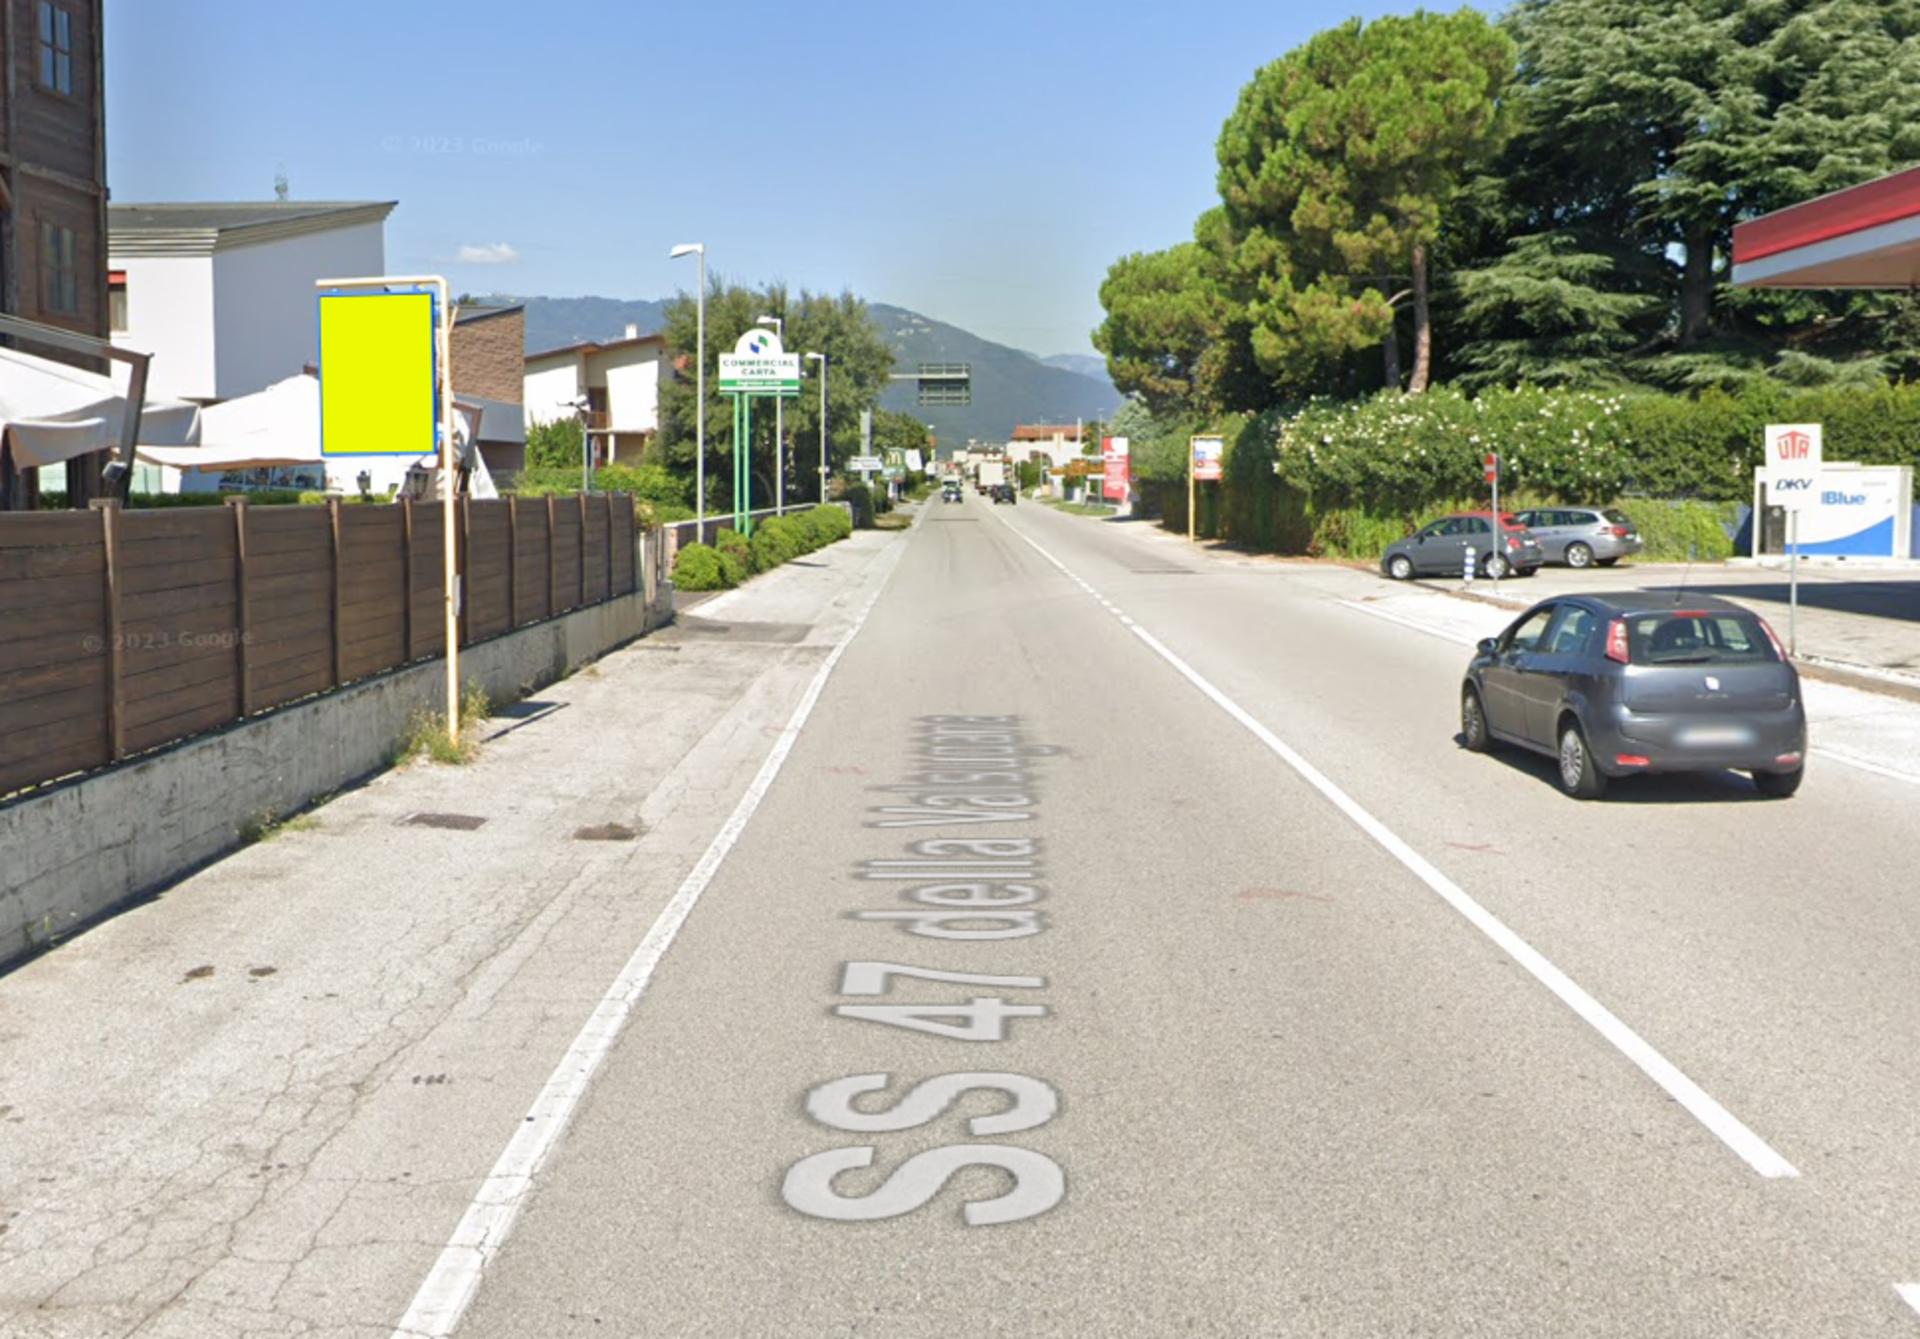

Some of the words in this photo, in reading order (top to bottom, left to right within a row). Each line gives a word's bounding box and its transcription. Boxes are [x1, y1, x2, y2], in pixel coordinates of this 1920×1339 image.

[722, 359, 795, 367] COMMERCIAL
[741, 368, 776, 376] CARTA
[1776, 430, 1811, 460] UTA
[1775, 479, 1813, 491] DKV
